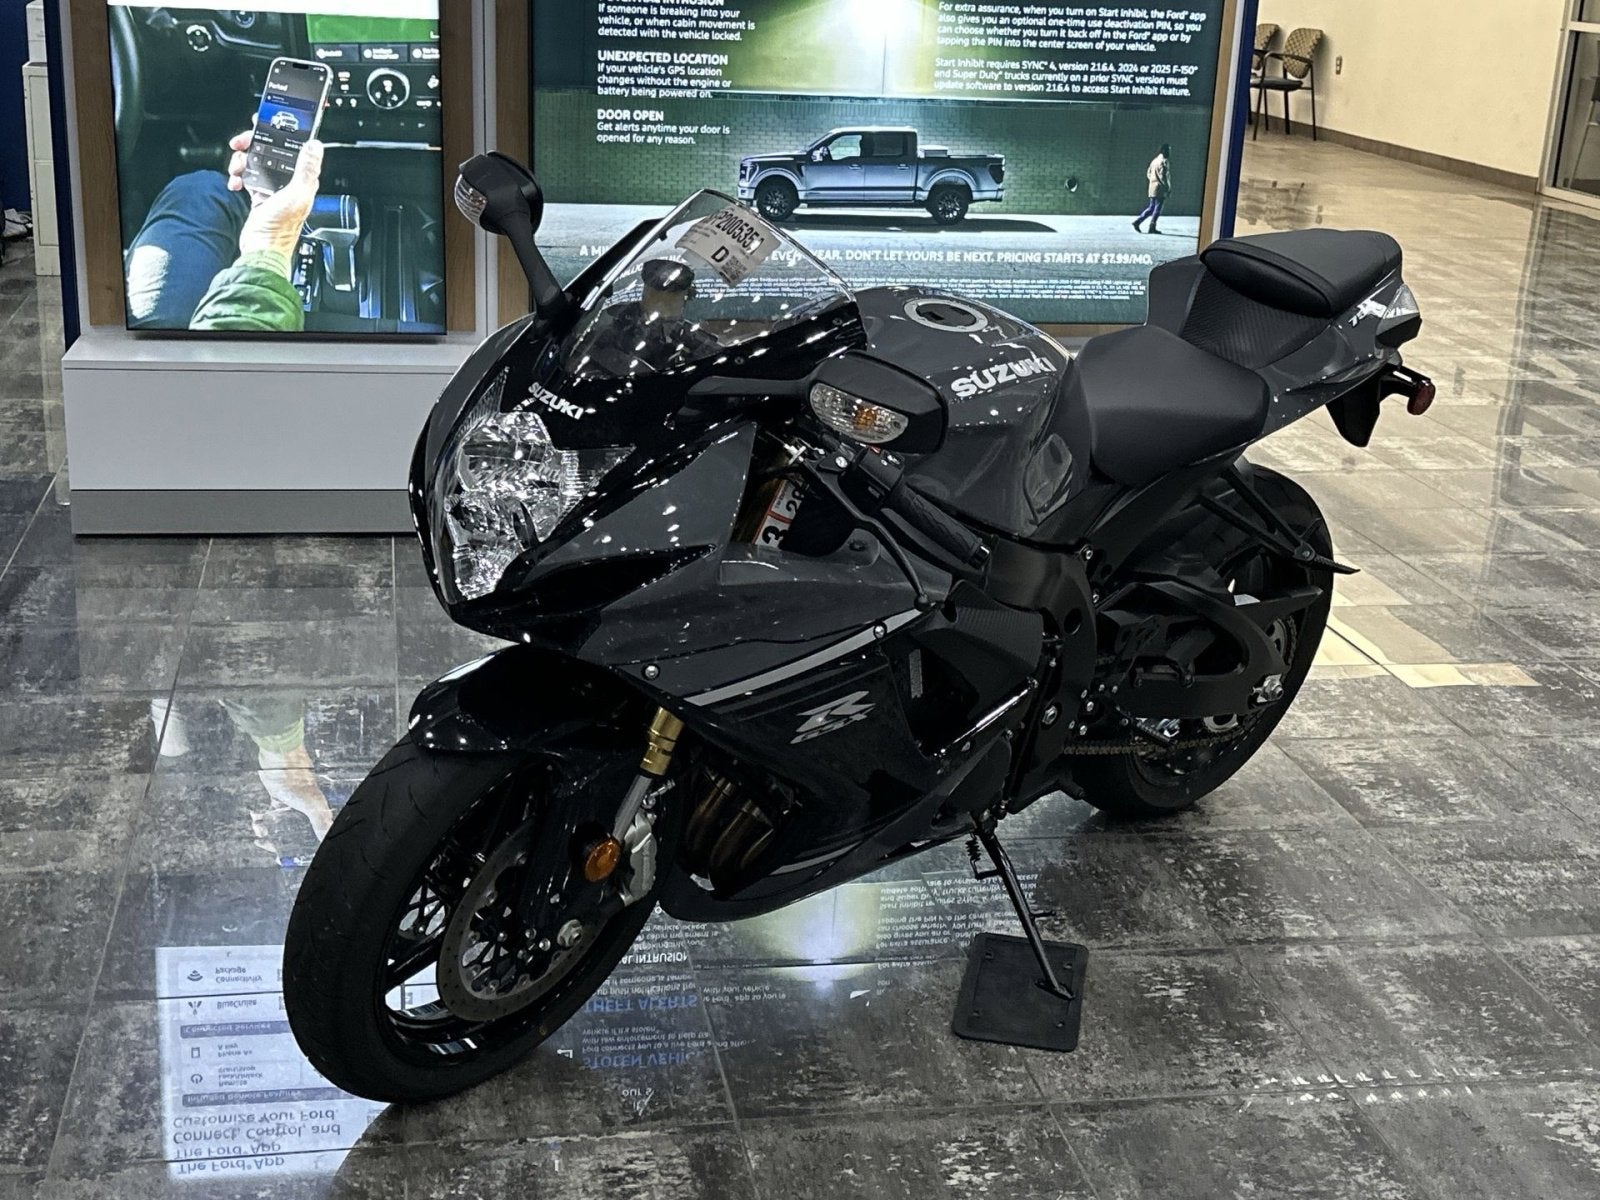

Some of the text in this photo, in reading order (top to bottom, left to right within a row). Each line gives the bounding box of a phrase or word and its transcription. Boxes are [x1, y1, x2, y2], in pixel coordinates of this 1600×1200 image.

[598, 3, 605, 12] If
[607, 6, 647, 14] someone
[651, 6, 657, 14] is
[660, 7, 698, 18] breaking
[701, 8, 717, 17] into
[720, 9, 740, 18] your
[939, 2, 953, 11] For
[955, 4, 976, 12] extra
[978, 5, 1021, 14] assurance,
[1024, 6, 1046, 14] when
[1049, 8, 1064, 16] you
[1066, 7, 1083, 16] turn
[1099, 8, 1119, 17] Start
[1151, 9, 1164, 18] the
[1190, 12, 1206, 21] app
[598, 16, 755, 30] vehicle, or when cabin movement is
[938, 14, 955, 22] also
[958, 15, 980, 24] gives
[982, 16, 997, 25] you
[1012, 16, 1046, 26] optional
[1048, 17, 1085, 27] one-time
[1104, 19, 1154, 29] deactivation
[1186, 23, 1201, 32] you
[598, 27, 742, 40] detected with the vehicle locked.
[938, 26, 952, 34] can
[955, 25, 984, 35] choose
[986, 27, 1021, 36] whether
[1023, 29, 1038, 37] you
[1040, 28, 1058, 36] turn
[1060, 29, 1066, 38] it
[1068, 29, 1087, 38] back
[1089, 29, 1101, 38] off
[1103, 30, 1110, 38] in
[1113, 31, 1126, 39] the
[1152, 33, 1168, 42] app
[1181, 33, 1191, 43] by
[972, 38, 985, 46] the
[988, 38, 1002, 46] PIN
[1004, 38, 1020, 47] into
[1023, 39, 1037, 48] the
[1039, 40, 1065, 48] center
[1066, 41, 1093, 49] screen
[1095, 40, 1104, 49] of
[1106, 43, 1124, 51] your
[598, 50, 728, 65] UNEXPECTED LOCATION
[598, 63, 722, 76] If your vehicle's GPS location
[935, 58, 955, 66] Start
[958, 58, 985, 68] Inhibit
[987, 60, 1020, 69] requires
[1059, 62, 1088, 71] version
[1118, 63, 1138, 72] 2024
[1151, 64, 1171, 73] 2025
[598, 75, 732, 88] changes without the engine or
[934, 69, 950, 78] and
[953, 70, 976, 79] Super
[1005, 72, 1030, 80] trucks
[1032, 72, 1068, 82] currently
[1090, 74, 1110, 83] prior
[1112, 74, 1134, 83] SYNC
[1136, 75, 1164, 84] version
[1167, 77, 1188, 85] must
[598, 86, 629, 97] battery
[632, 87, 656, 98] being
[659, 88, 697, 98] powered
[966, 81, 1001, 90] software
[1004, 82, 1012, 90] to
[1015, 82, 1044, 91] version
[1072, 84, 1080, 92] to
[1082, 86, 1108, 94] access
[1110, 85, 1130, 94] Start
[1132, 86, 1158, 95] Inhibit
[597, 109, 664, 121] DOOR OPEN
[597, 122, 730, 134] Get alerts anytime your door is
[597, 134, 695, 145] opened for any reason.
[579, 244, 589, 257] A
[845, 250, 882, 261] DON'T
[883, 250, 903, 262] LET
[905, 250, 944, 262] YOURS
[946, 251, 961, 262] BE
[997, 252, 1041, 263] PRICING
[1043, 252, 1084, 264] STARTS
[1085, 253, 1100, 264] AT
[711, 245, 730, 263] D
[951, 356, 1057, 398] SUZUKI
[527, 381, 585, 421] SUZUKI
